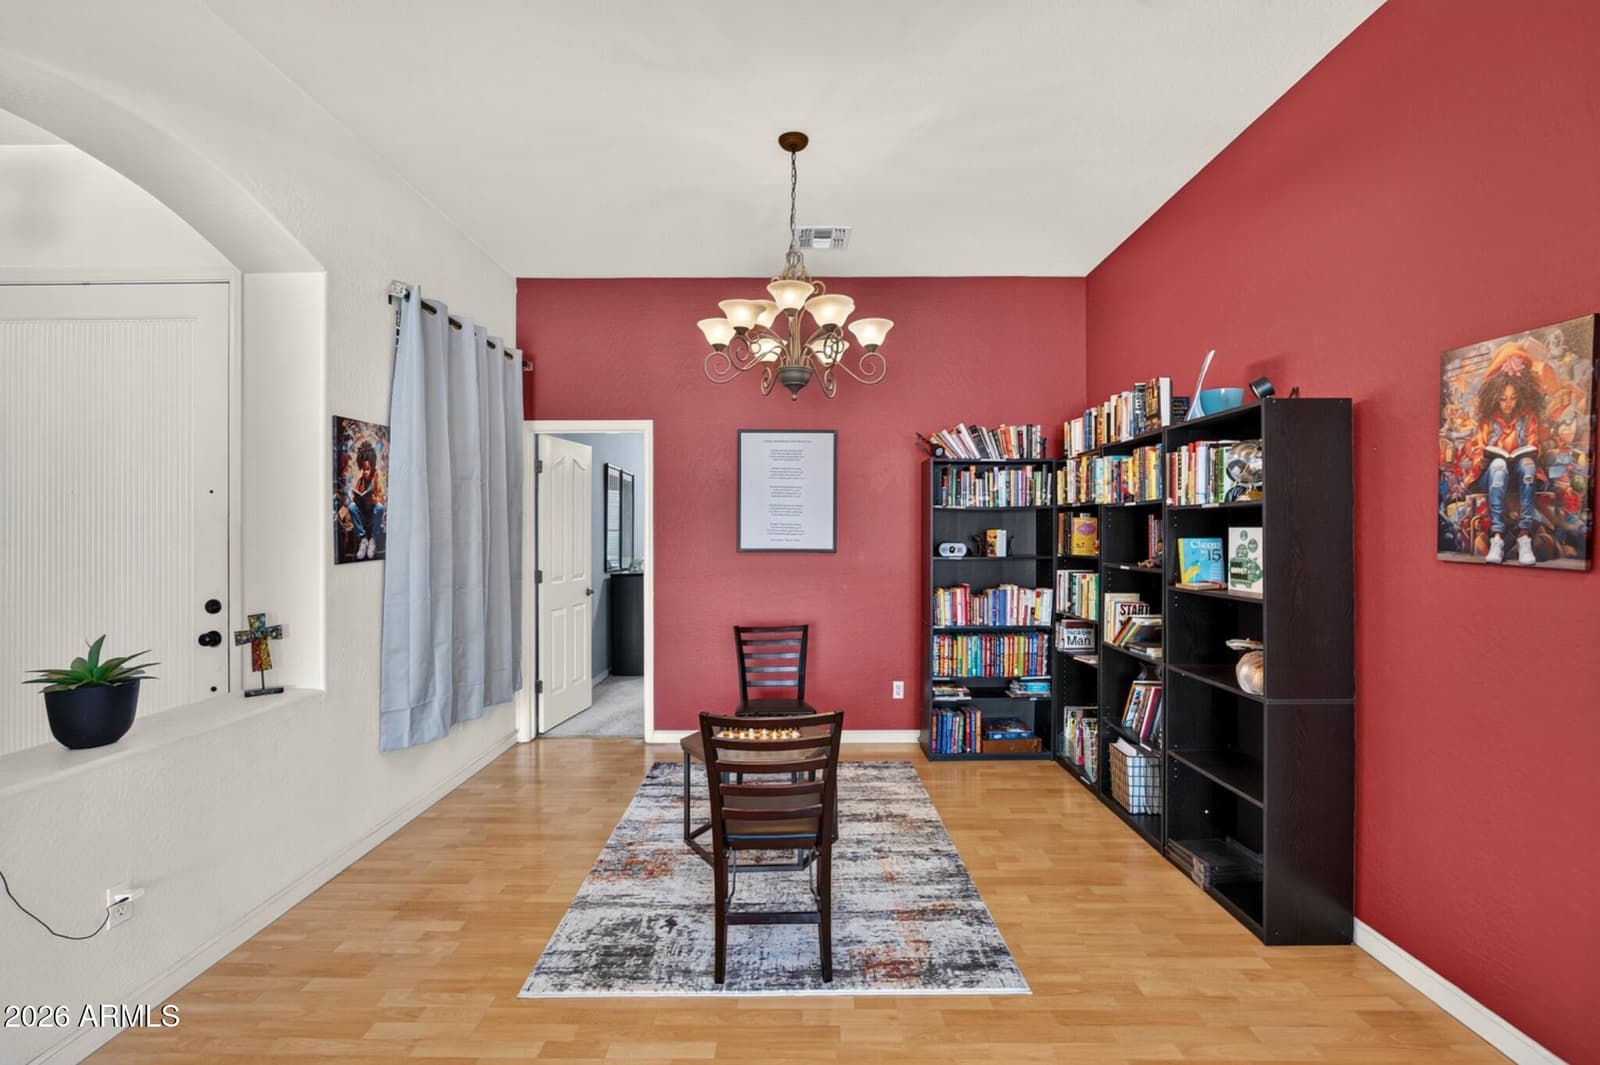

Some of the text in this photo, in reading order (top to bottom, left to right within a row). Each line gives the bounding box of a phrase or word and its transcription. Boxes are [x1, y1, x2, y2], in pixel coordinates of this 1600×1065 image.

[1207, 549, 1222, 561] 15
[1120, 604, 1150, 616] START
[1067, 635, 1092, 646] Man
